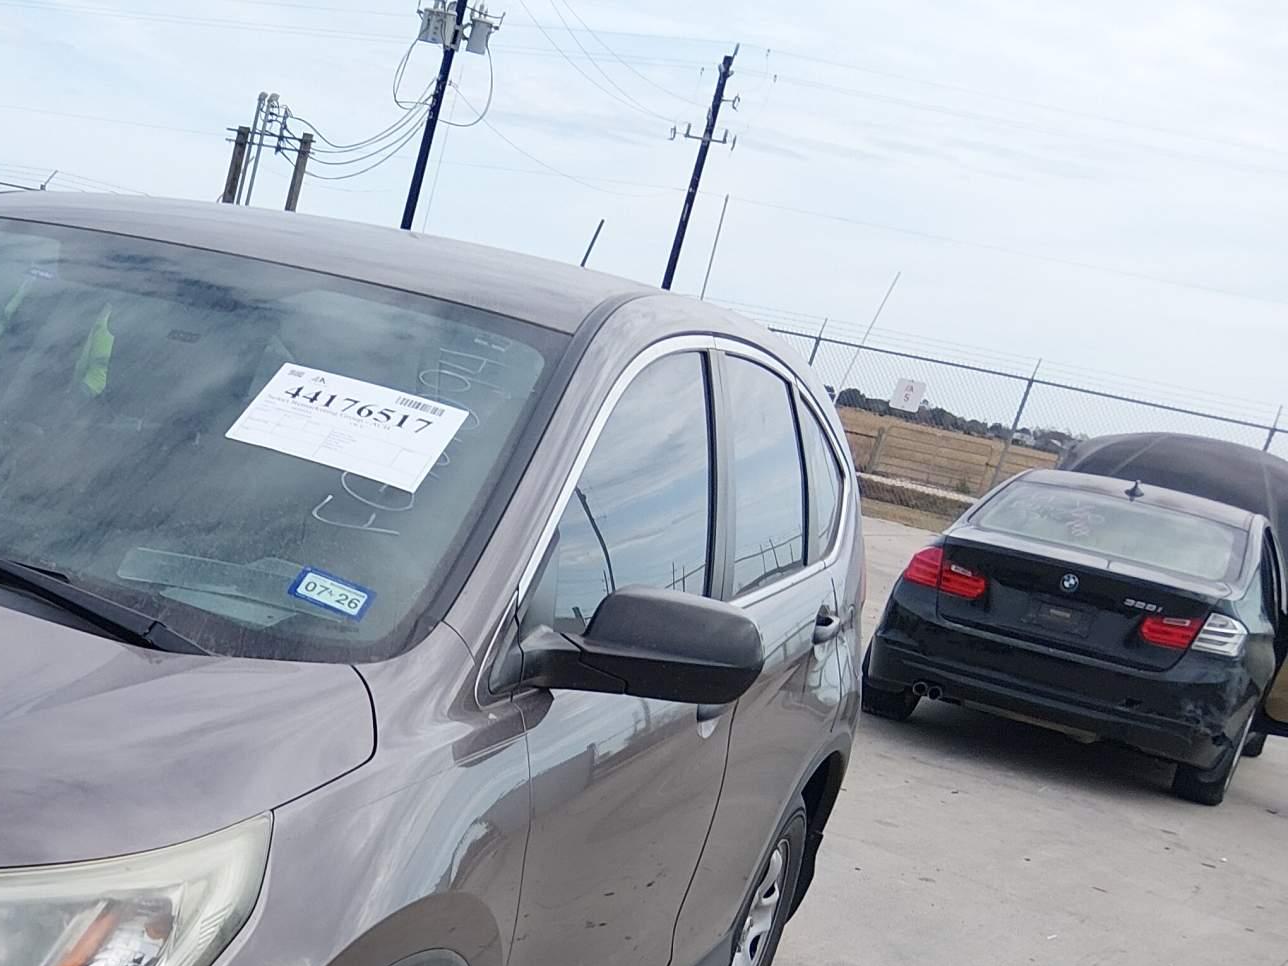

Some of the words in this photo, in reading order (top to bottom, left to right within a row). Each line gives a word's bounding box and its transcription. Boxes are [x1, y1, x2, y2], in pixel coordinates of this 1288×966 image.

[283, 385, 434, 435] 44176517
[304, 580, 329, 596] 07
[335, 593, 361, 611] 26
